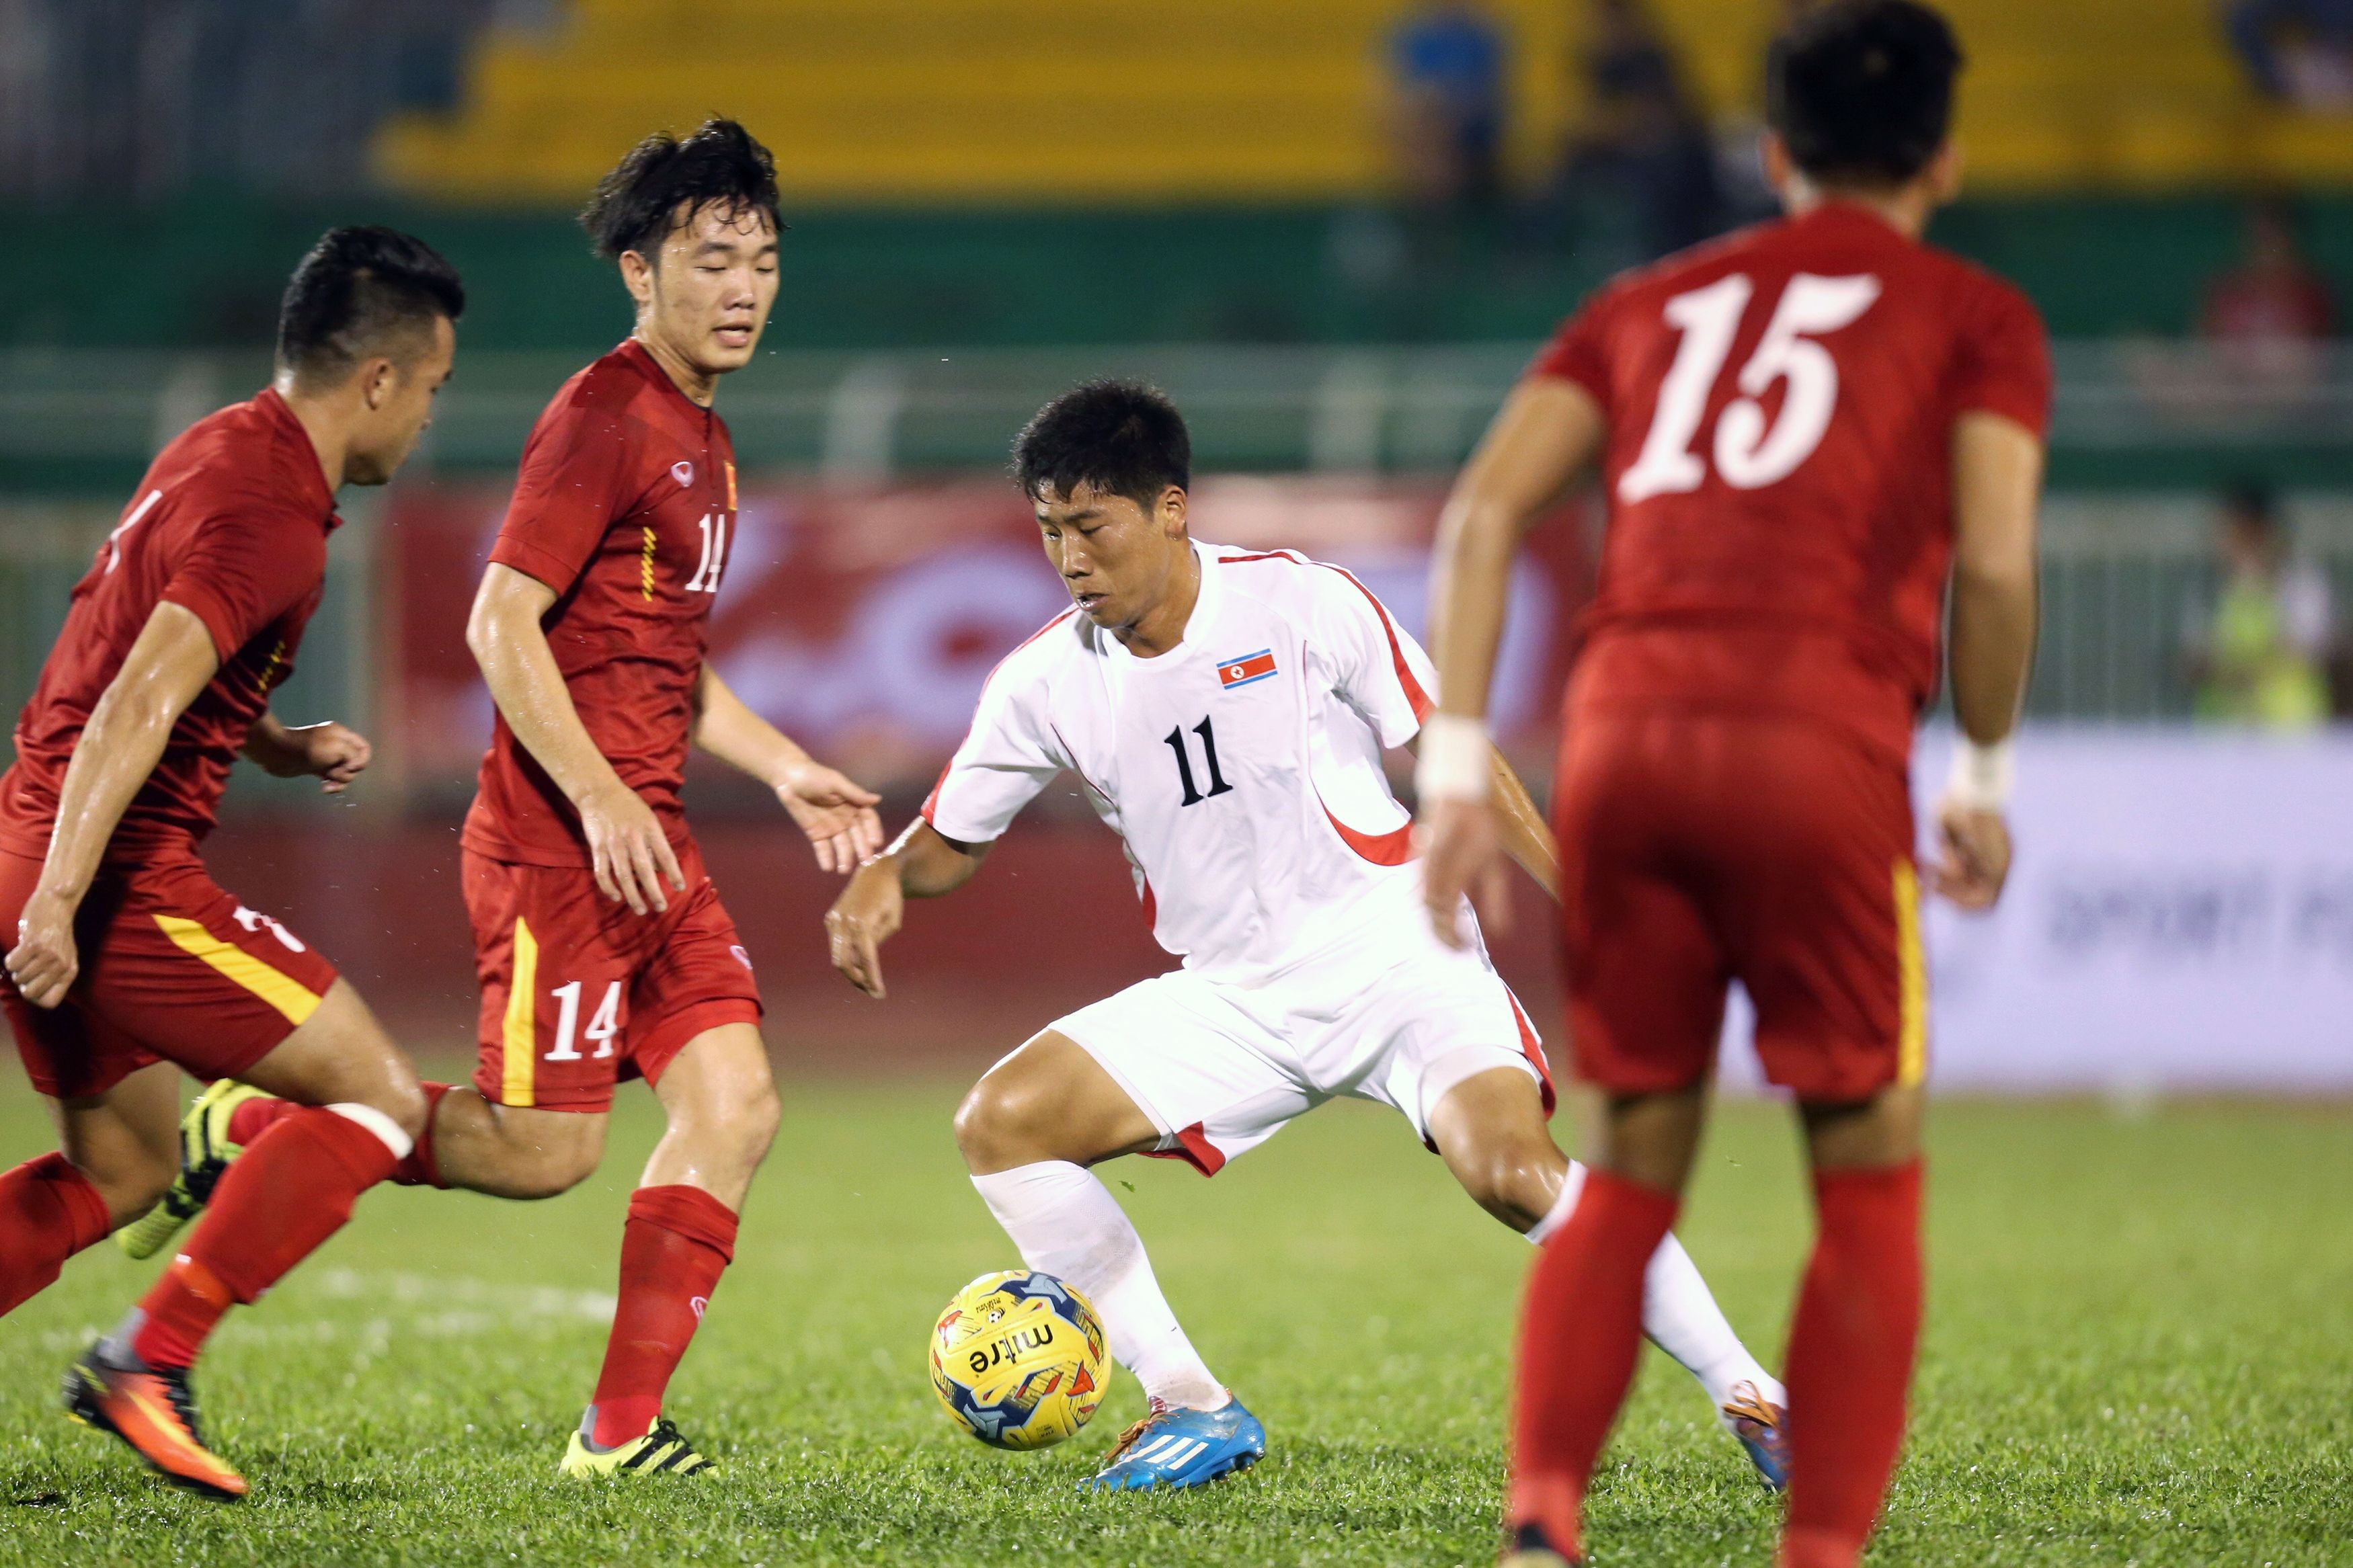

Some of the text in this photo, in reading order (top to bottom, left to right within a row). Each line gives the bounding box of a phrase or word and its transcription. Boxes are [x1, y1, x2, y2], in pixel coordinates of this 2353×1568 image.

[1617, 272, 1882, 506] 15
[1164, 714, 1234, 807] 11
[543, 980, 621, 1061] 14
[969, 1323, 1053, 1373] mitre
